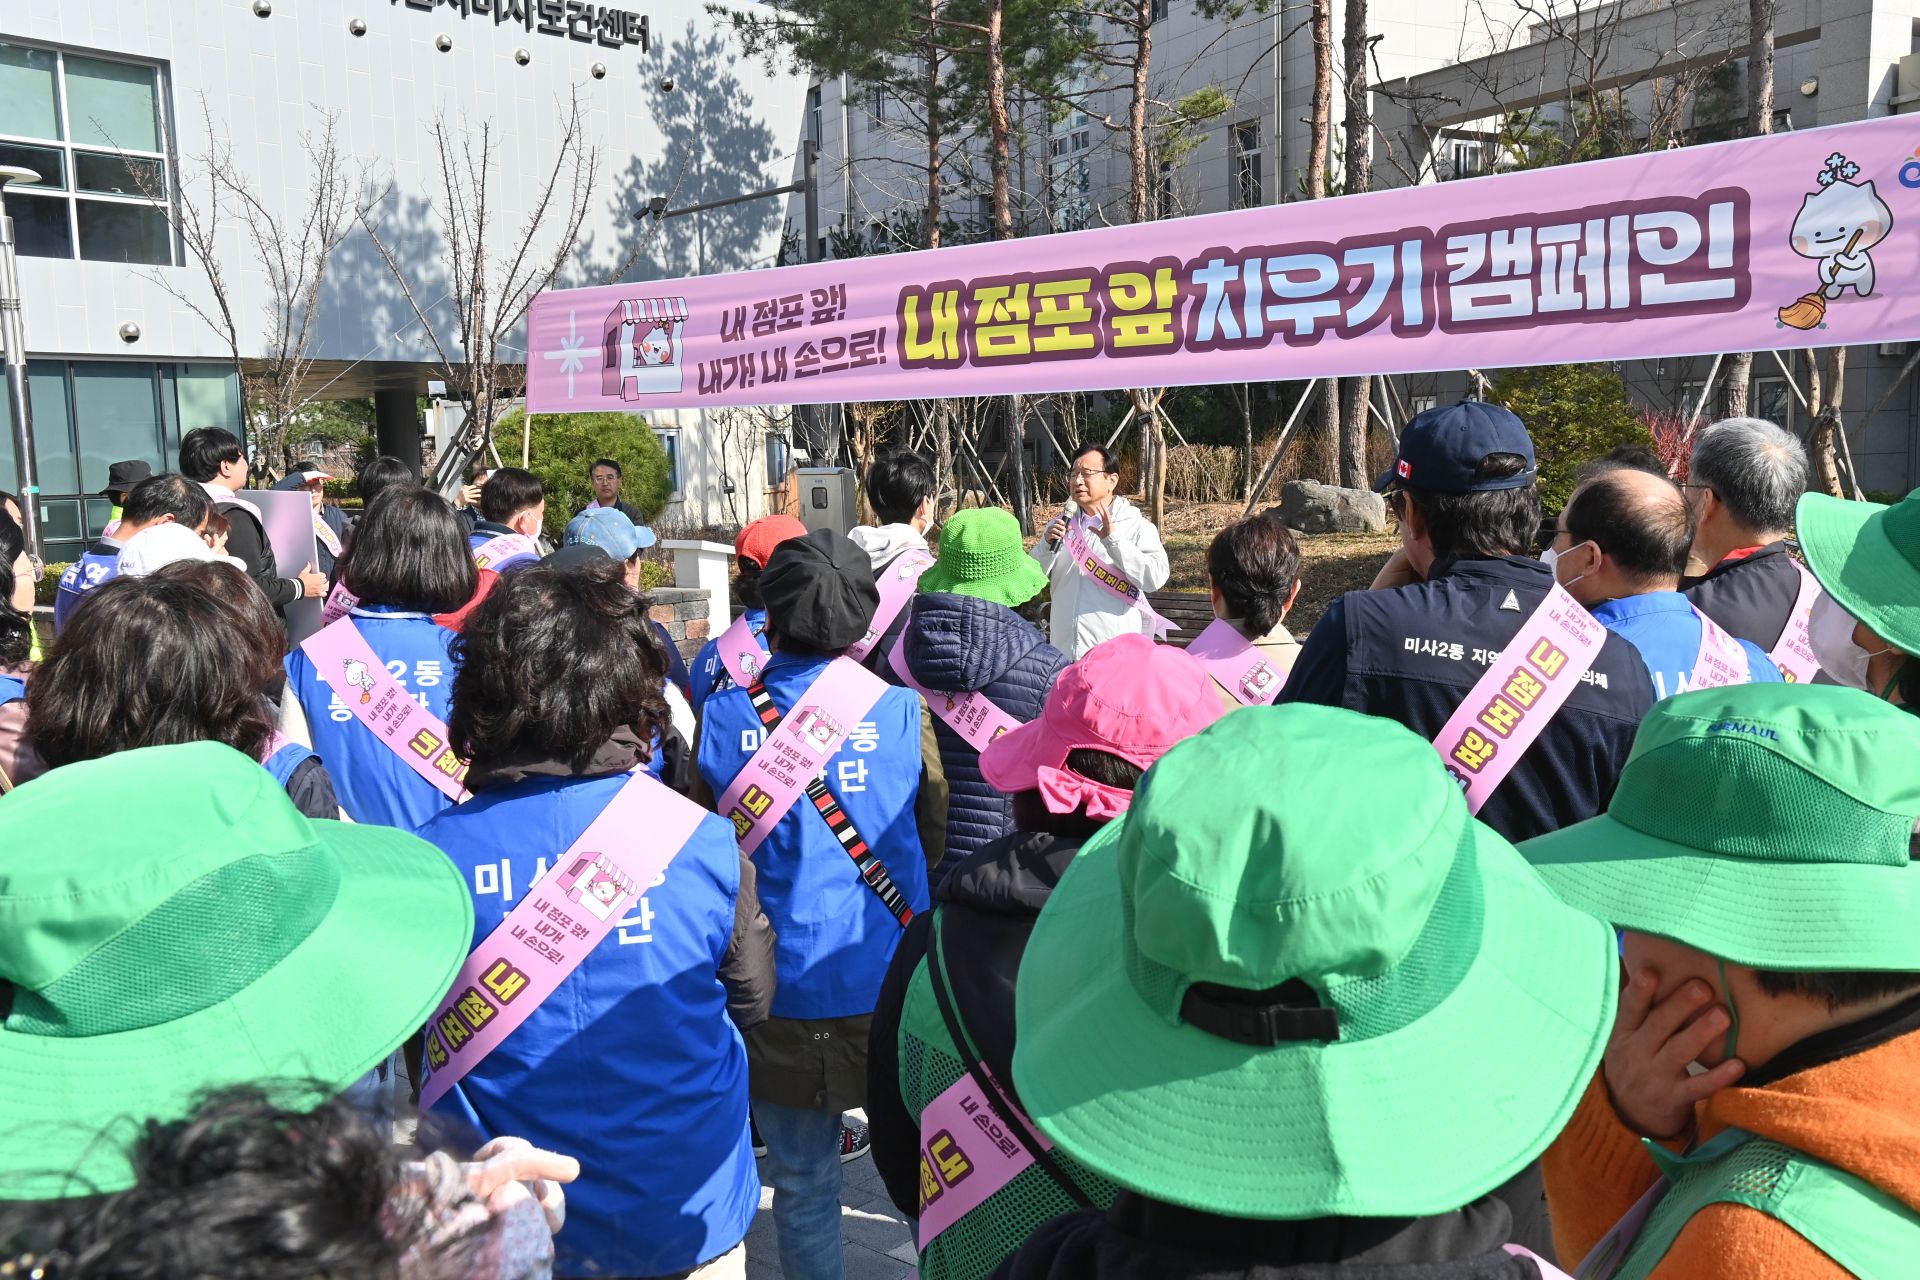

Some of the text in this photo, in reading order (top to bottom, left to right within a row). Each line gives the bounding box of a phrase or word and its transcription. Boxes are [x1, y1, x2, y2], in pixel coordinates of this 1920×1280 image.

[901, 194, 1743, 365] 내 점포 앞 치우기 캠페인
[720, 282, 847, 343] 내 점포 앞!
[697, 326, 887, 395] 내가! 내 손으로!
[1404, 637, 1464, 660] 미사2동
[1527, 637, 1567, 679] 내
[368, 710, 378, 722] 내
[373, 697, 390, 715] 점포
[382, 703, 399, 722] 내가!
[385, 704, 413, 737] 내 손으로!
[1478, 667, 1546, 738] 점포
[409, 729, 442, 759] 내
[772, 739, 814, 770] 내 점포 앞!
[774, 755, 797, 772] 내가!
[1451, 728, 1497, 773] 앞
[757, 759, 770, 771] 내
[767, 765, 797, 789] 손으로!
[740, 785, 773, 818] 내
[533, 898, 590, 941] 내 점포 앞!
[534, 920, 565, 945] 내가!
[510, 924, 565, 965] 내 손으로!
[481, 960, 529, 1004] 내
[438, 988, 497, 1051] 점포
[960, 1095, 980, 1116] 내
[973, 1113, 1021, 1159] 손으로!
[929, 1132, 972, 1186] 내
